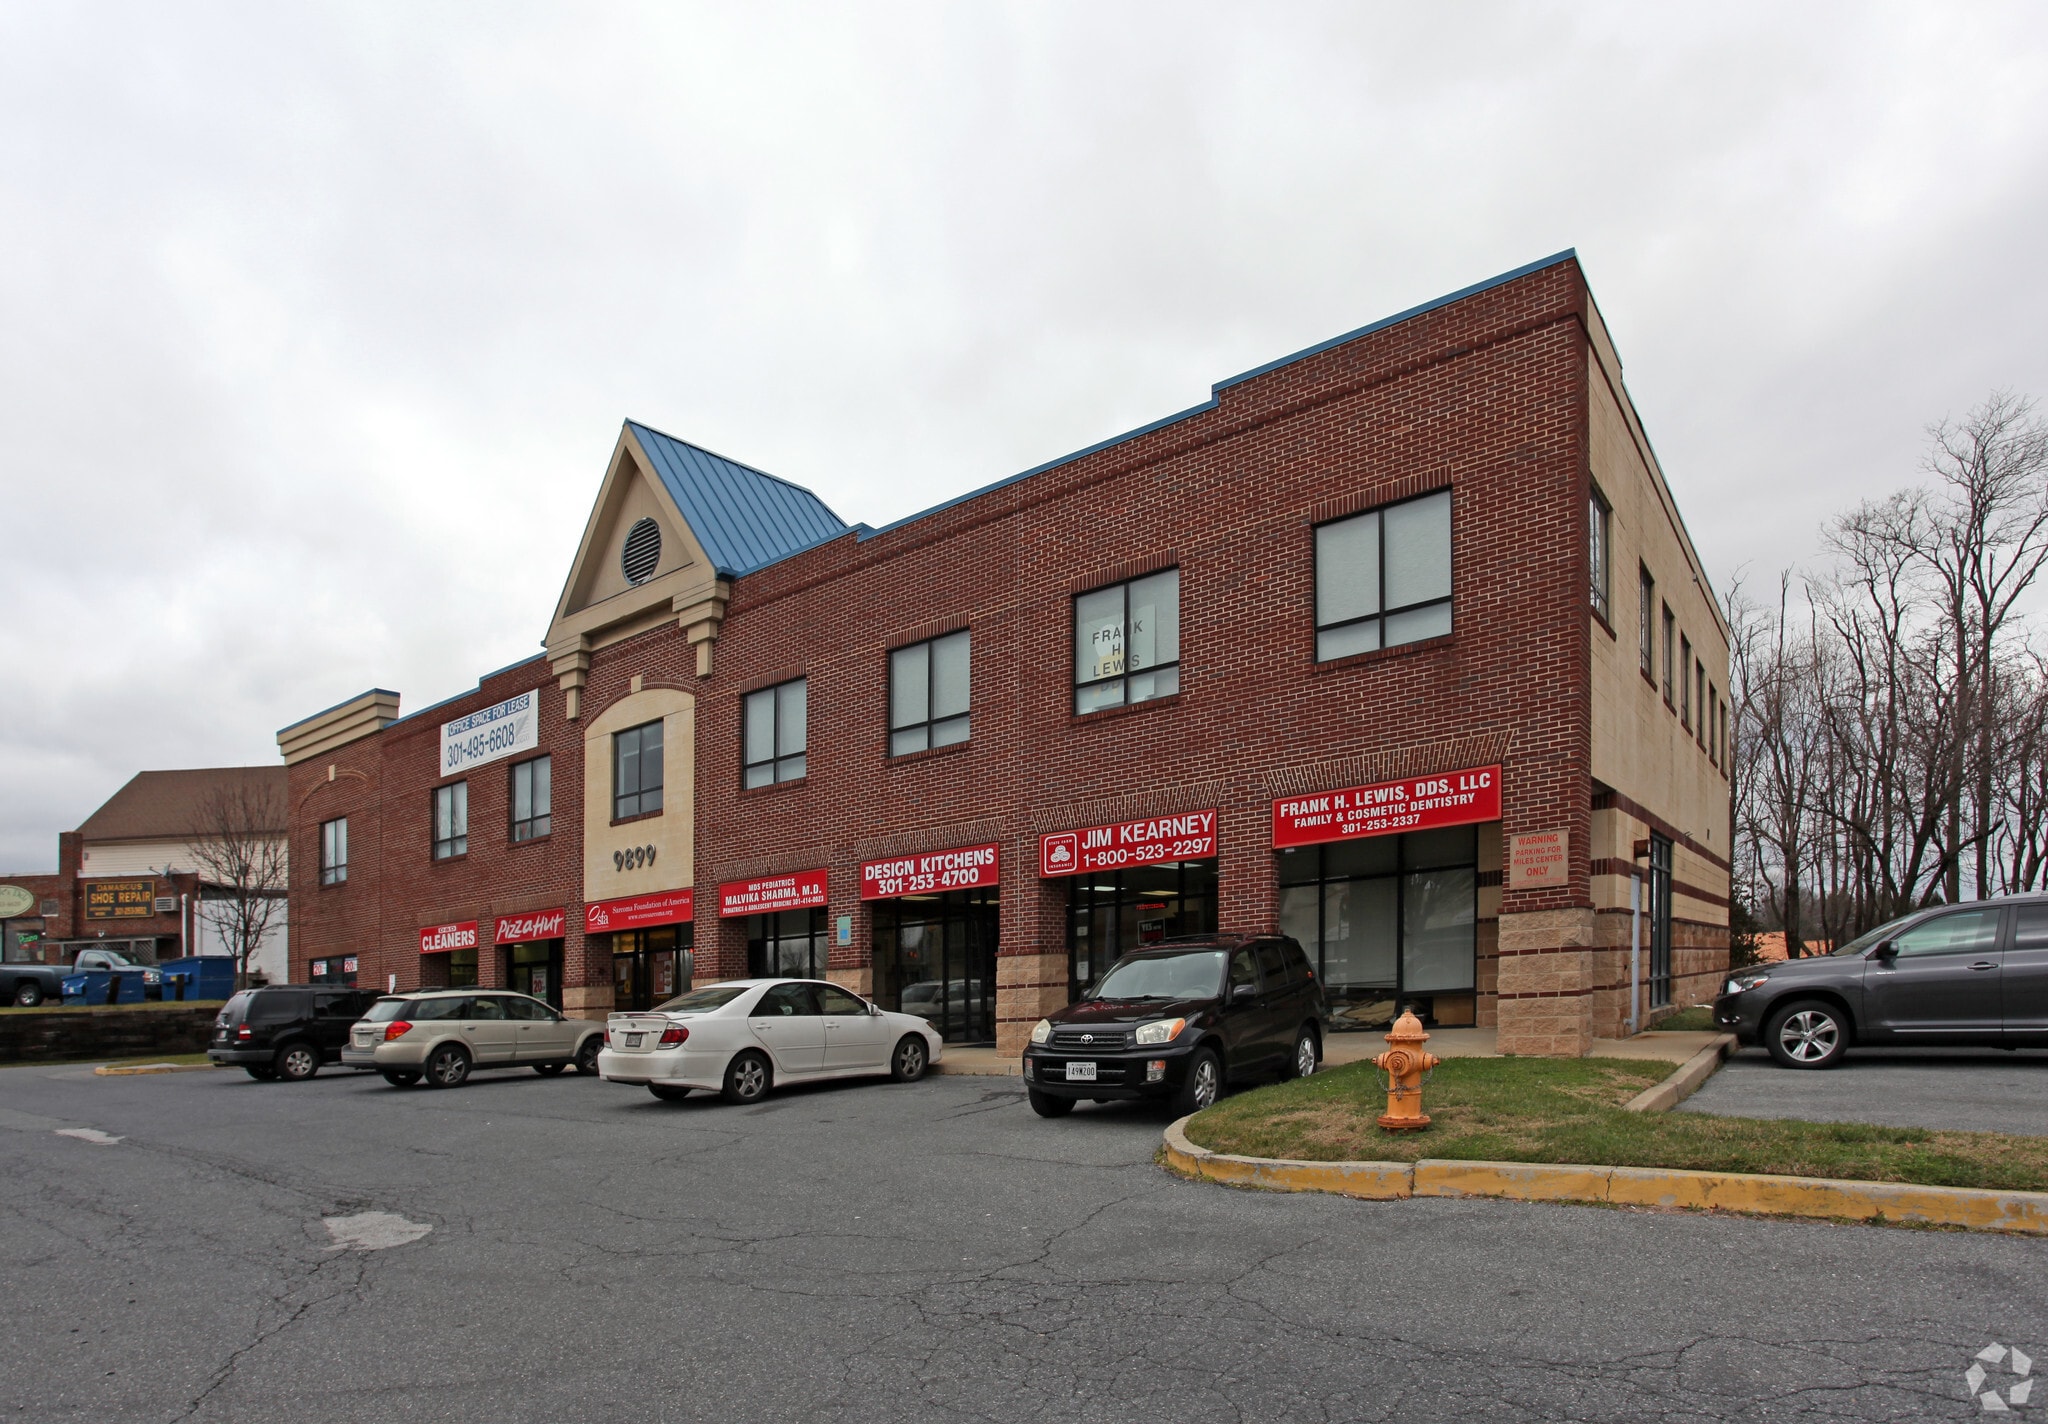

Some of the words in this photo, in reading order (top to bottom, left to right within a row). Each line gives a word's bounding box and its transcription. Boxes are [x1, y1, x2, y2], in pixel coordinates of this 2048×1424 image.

[1092, 620, 1143, 645] FRAK
[1112, 643, 1121, 656] H
[1093, 654, 1140, 677] LEWS
[449, 717, 470, 736] OFFICE
[471, 709, 491, 728] SPACE
[492, 705, 506, 719] FOR
[507, 694, 529, 714] LEASE
[447, 722, 515, 768] 301-495-6608
[1280, 797, 1329, 818] FRANK
[1334, 794, 1350, 809] H.
[1355, 785, 1410, 807] LEWIS,
[1415, 778, 1454, 798] DDS,
[1460, 772, 1491, 791] LLC
[1294, 813, 1333, 829] FAMILY
[1335, 812, 1345, 823] &
[1347, 802, 1407, 821] COSMETIC
[1410, 792, 1476, 812] DENTISTRY
[1081, 828, 1112, 850] JIM
[1120, 812, 1214, 844] KEARNEY
[1341, 813, 1421, 834] 301-253-2337
[1515, 847, 1546, 857] PARKING
[1547, 845, 1562, 853] FOR
[1517, 833, 1559, 846] WARNING
[613, 843, 657, 872] 9899
[1083, 837, 1213, 868] 1-800-523-2297
[1513, 857, 1534, 866] MILES
[1535, 854, 1563, 864] CENTER
[865, 859, 915, 881] DESIGN
[920, 848, 995, 873] KITCHENS
[1526, 866, 1549, 877] ONLY
[96, 883, 143, 892] DAMASCUS
[748, 883, 761, 892] MDS
[761, 878, 796, 890] PEDIATRICS
[878, 867, 979, 895] 301-253-4700
[90, 892, 115, 905] SHOE
[118, 890, 151, 903] REPAIR
[612, 906, 633, 914] Sarcoma
[633, 900, 662, 912] Foundation
[662, 898, 668, 907] of
[668, 896, 690, 907] America
[725, 892, 760, 906] MALVIKA
[761, 887, 800, 901] SHARMA,
[802, 883, 822, 895] M.D.
[722, 906, 744, 915] PEDIATRICS
[748, 902, 772, 911] ADOLESCENT
[772, 900, 792, 908] MEDICINE
[496, 919, 533, 942] Pizza
[531, 913, 564, 938] Hut
[422, 929, 476, 951] CLEANERS
